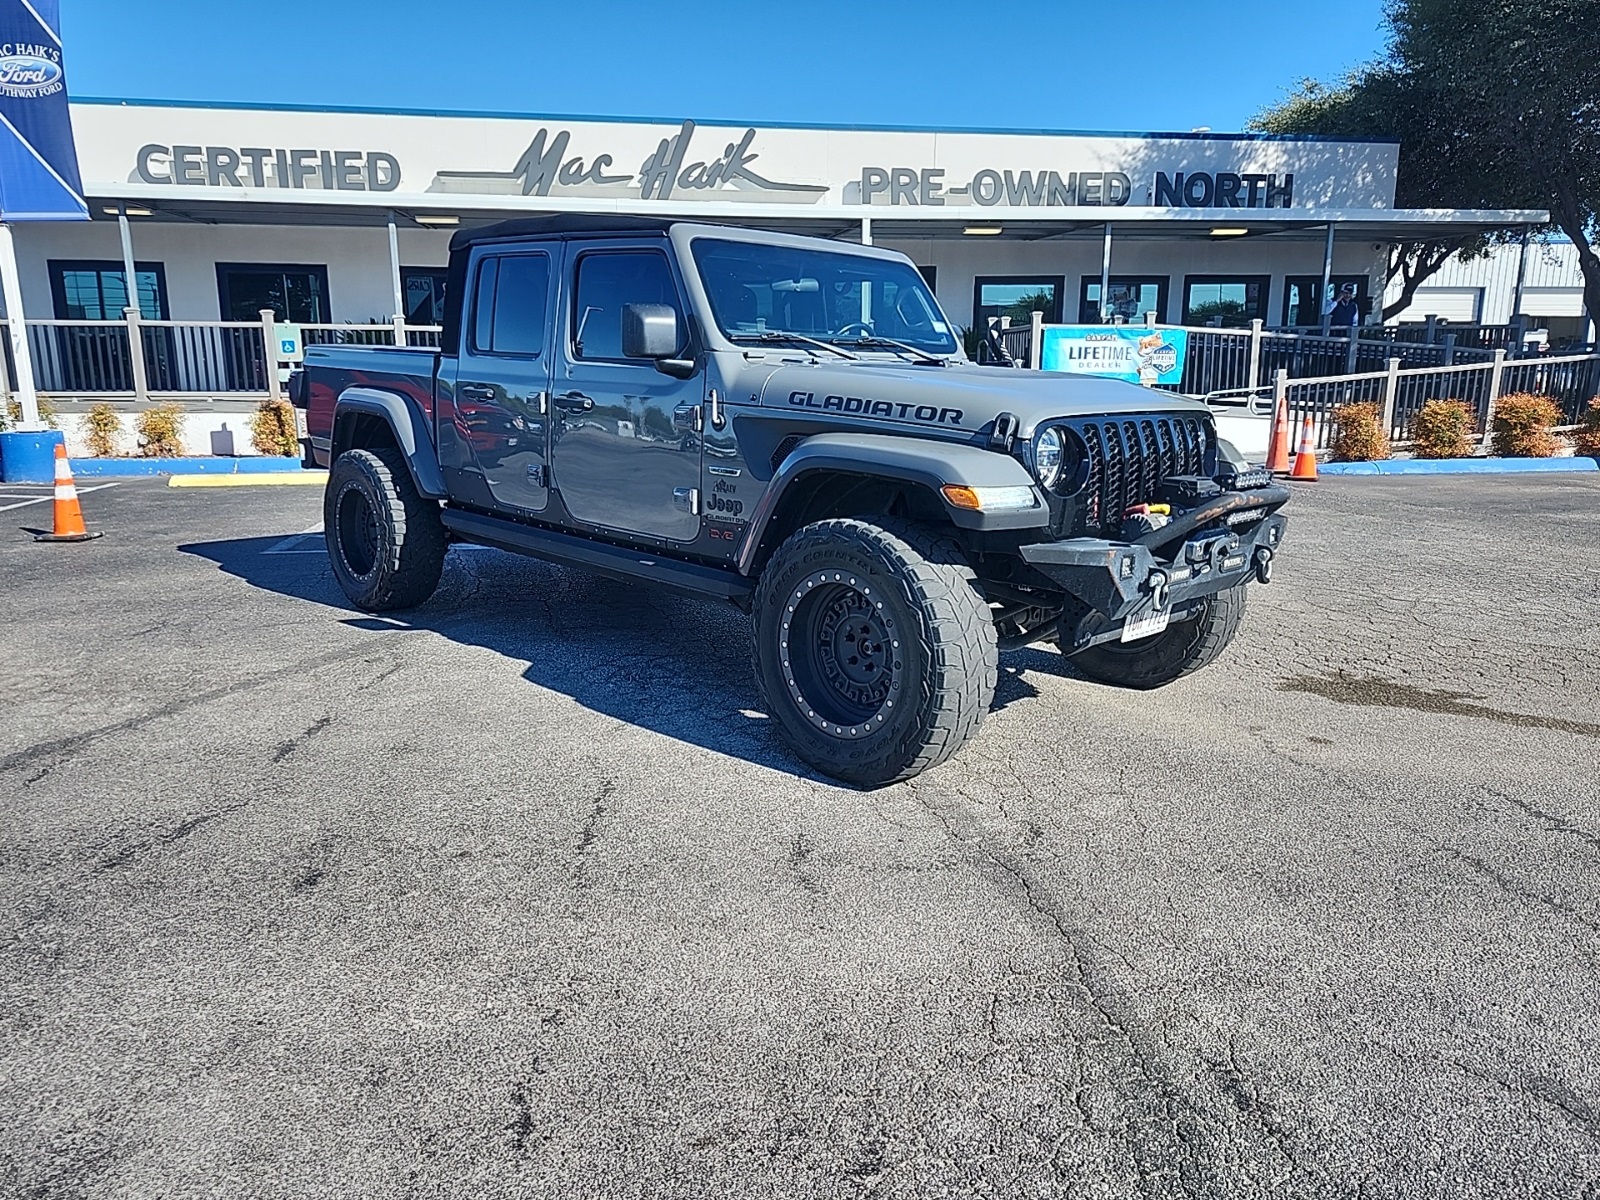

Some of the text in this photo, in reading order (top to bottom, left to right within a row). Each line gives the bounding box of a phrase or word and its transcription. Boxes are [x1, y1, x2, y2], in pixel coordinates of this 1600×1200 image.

[15, 43, 60, 62] HAIK'S
[0, 60, 47, 83] Ford
[38, 81, 63, 97] FORD
[136, 119, 1295, 209] CERTIFIED Mac Haik PRE-OWNED NORTH
[1069, 346, 1133, 361] LIFETIME
[788, 391, 964, 425] GLADIATOR
[706, 493, 743, 516] Jeep
